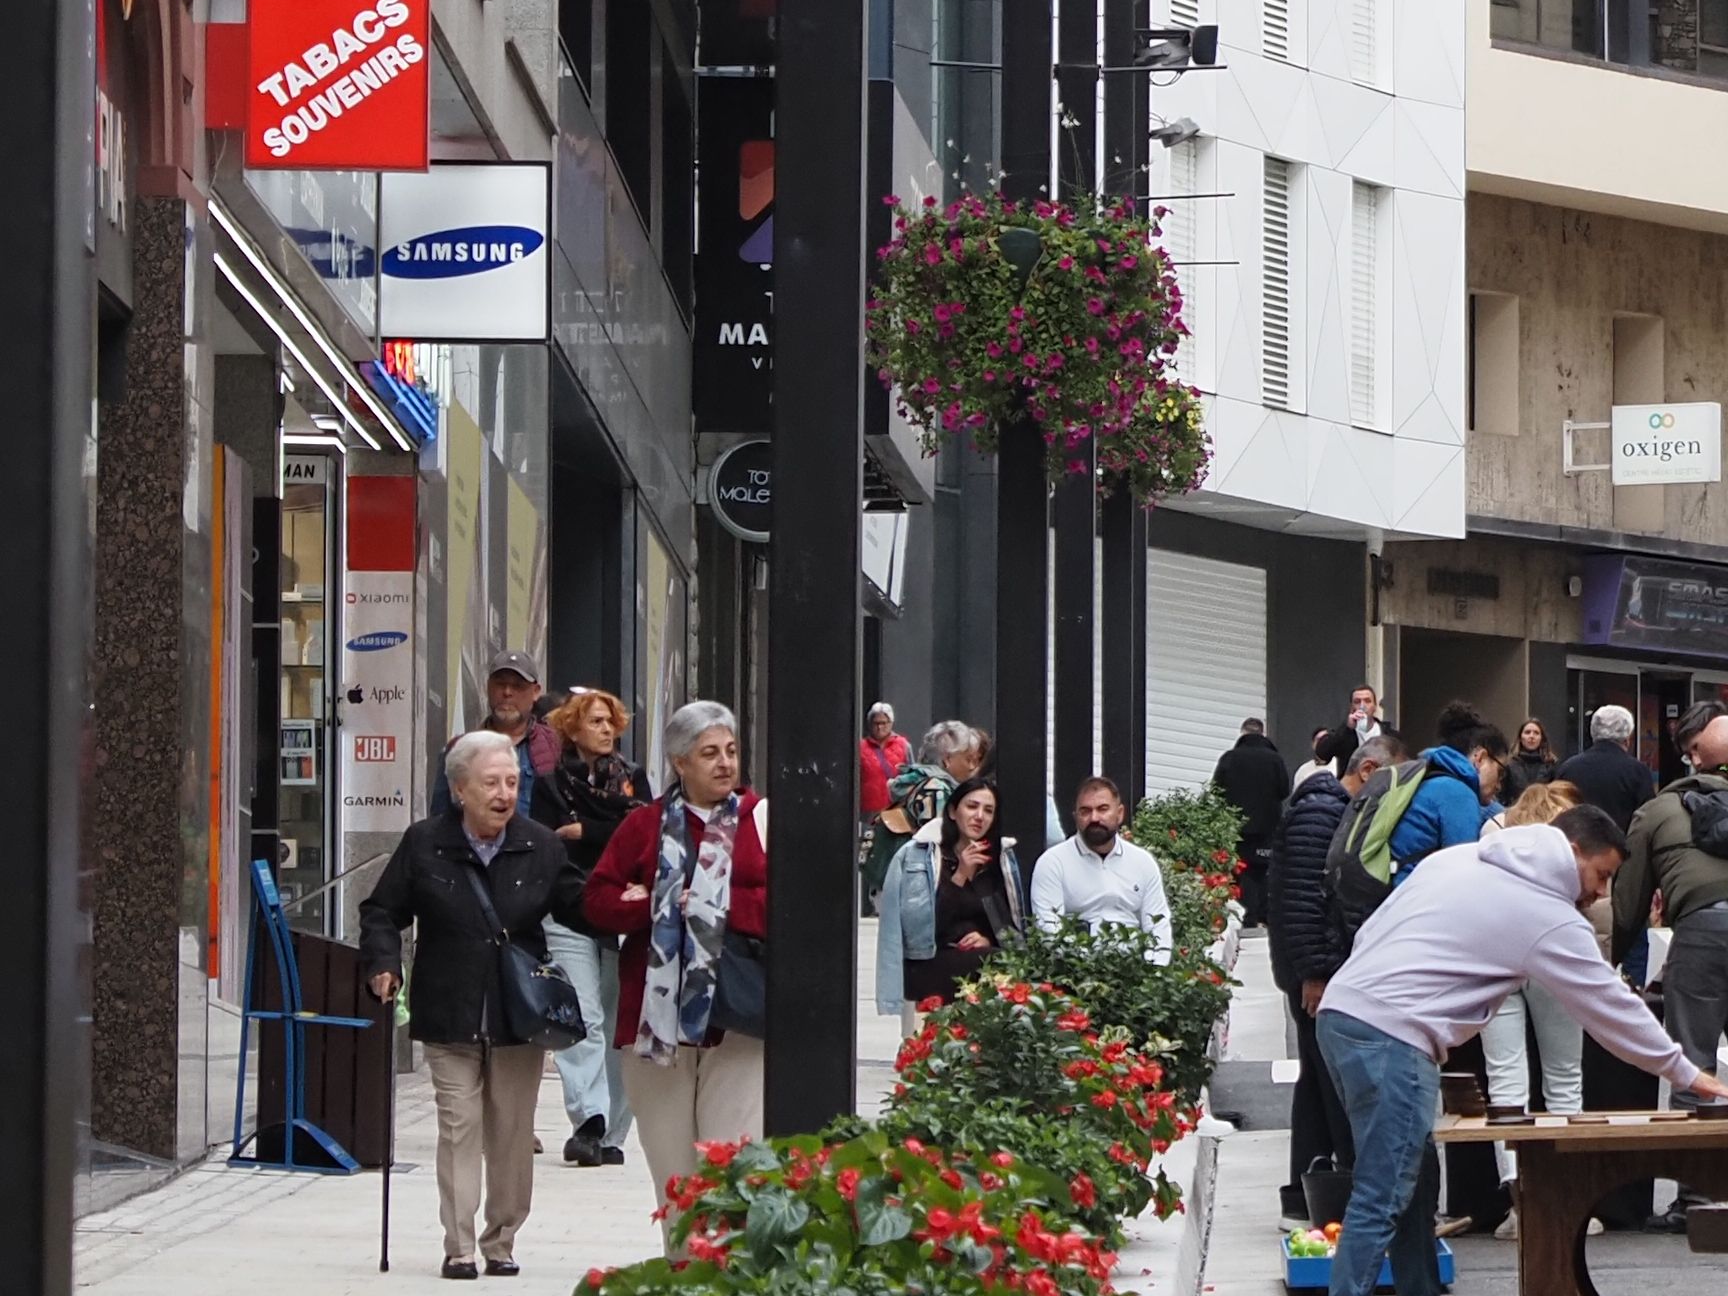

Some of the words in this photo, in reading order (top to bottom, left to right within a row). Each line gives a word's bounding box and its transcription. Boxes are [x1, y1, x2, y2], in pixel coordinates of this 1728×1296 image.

[263, 34, 424, 157] SOUVENIRS
[397, 242, 524, 262] SAMSUNG
[1622, 435, 1702, 462] oxigen
[353, 636, 401, 647] SAMSUNG
[370, 685, 405, 704] Apple
[356, 737, 395, 761] JBL
[344, 795, 404, 807] GARMIN
